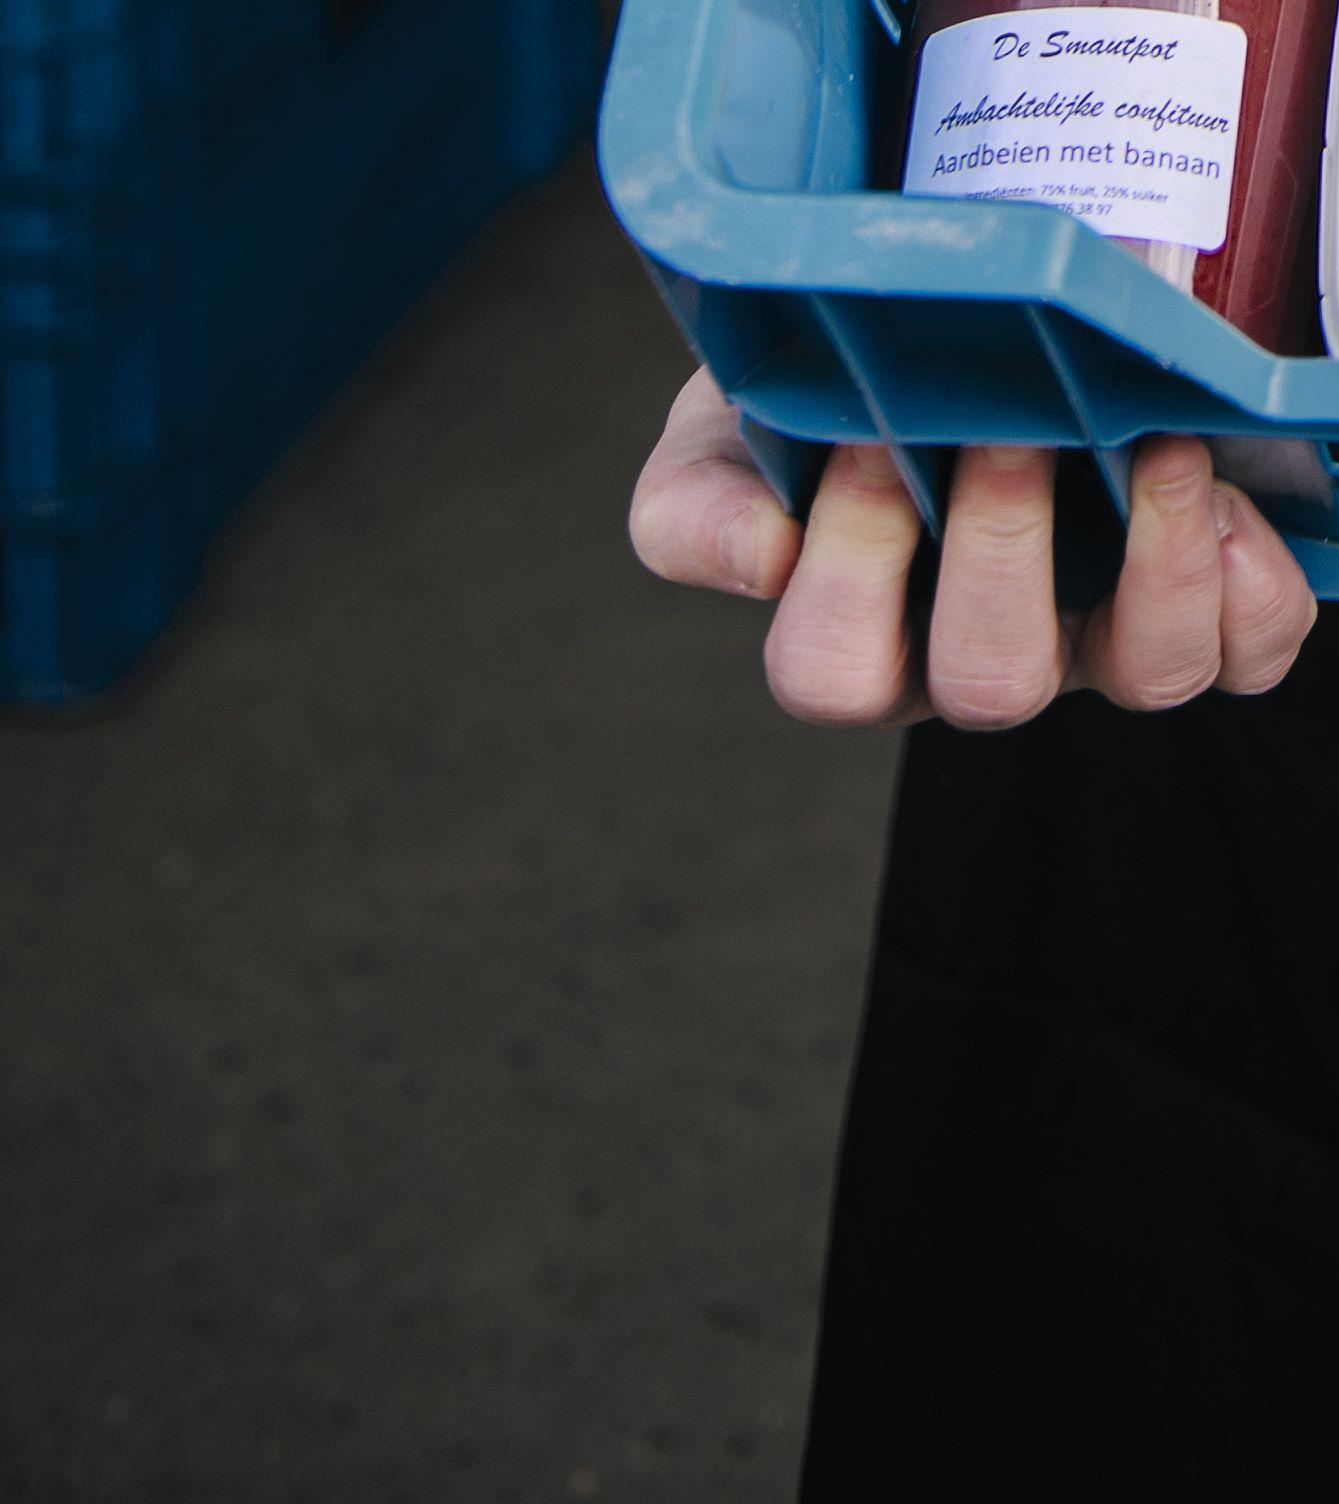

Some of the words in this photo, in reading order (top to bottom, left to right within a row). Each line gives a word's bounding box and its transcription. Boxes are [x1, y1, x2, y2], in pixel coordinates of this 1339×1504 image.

[992, 32, 1030, 60] De
[1039, 30, 1179, 64] Smautpot
[934, 91, 1105, 136] Ambachtelijke
[1114, 98, 1231, 134] confituur
[931, 141, 1050, 177] Aardbeien
[1060, 143, 1114, 164] met
[1125, 142, 1221, 179] banaan
